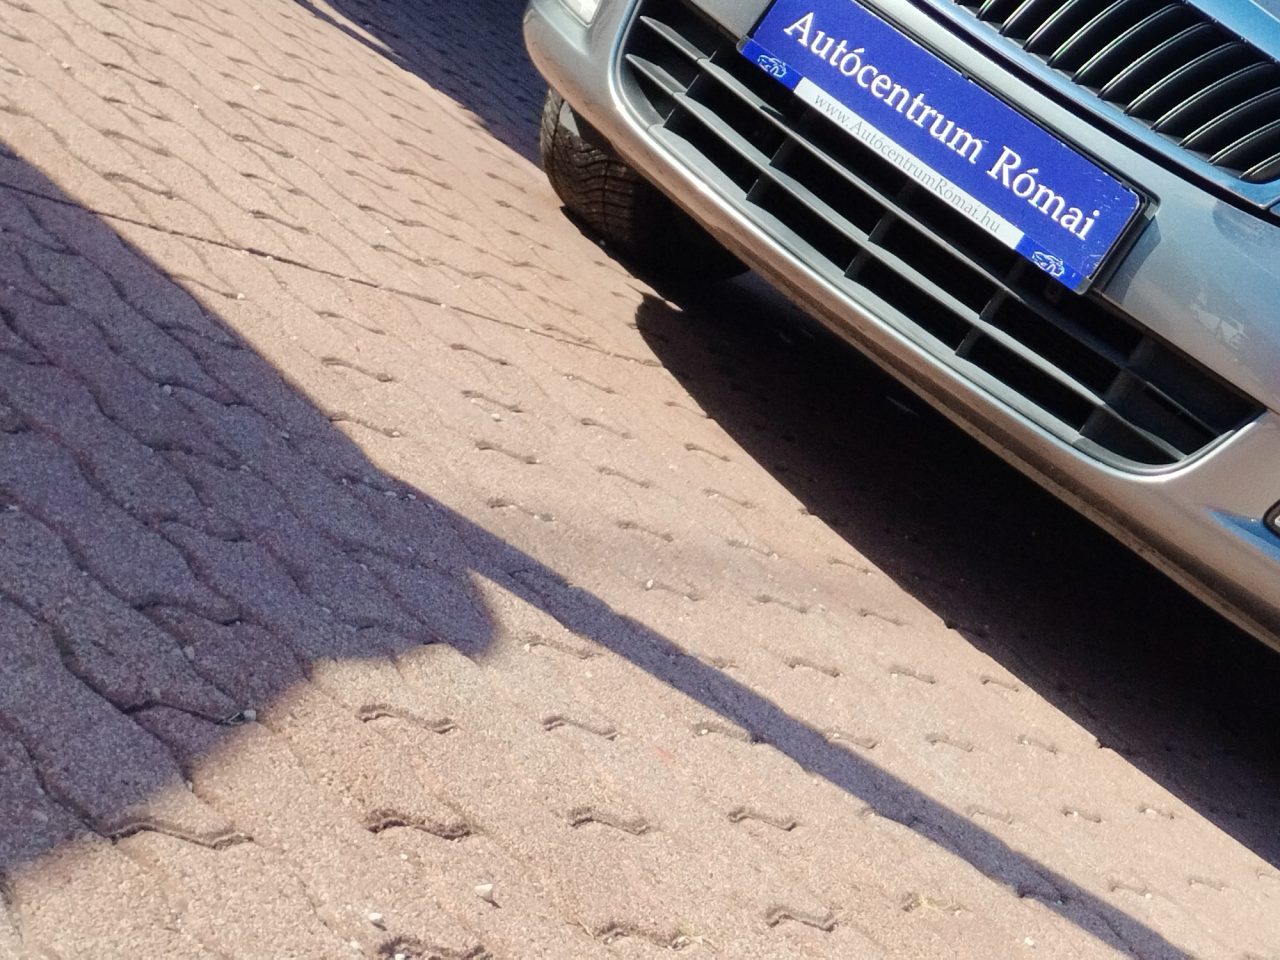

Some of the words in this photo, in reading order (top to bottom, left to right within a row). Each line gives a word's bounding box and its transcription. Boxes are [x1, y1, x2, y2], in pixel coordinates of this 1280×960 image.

[783, 11, 984, 165] Autócentrum
[986, 144, 1101, 240] Római
[814, 94, 1001, 234] www.AutócentrumRómai.hu
